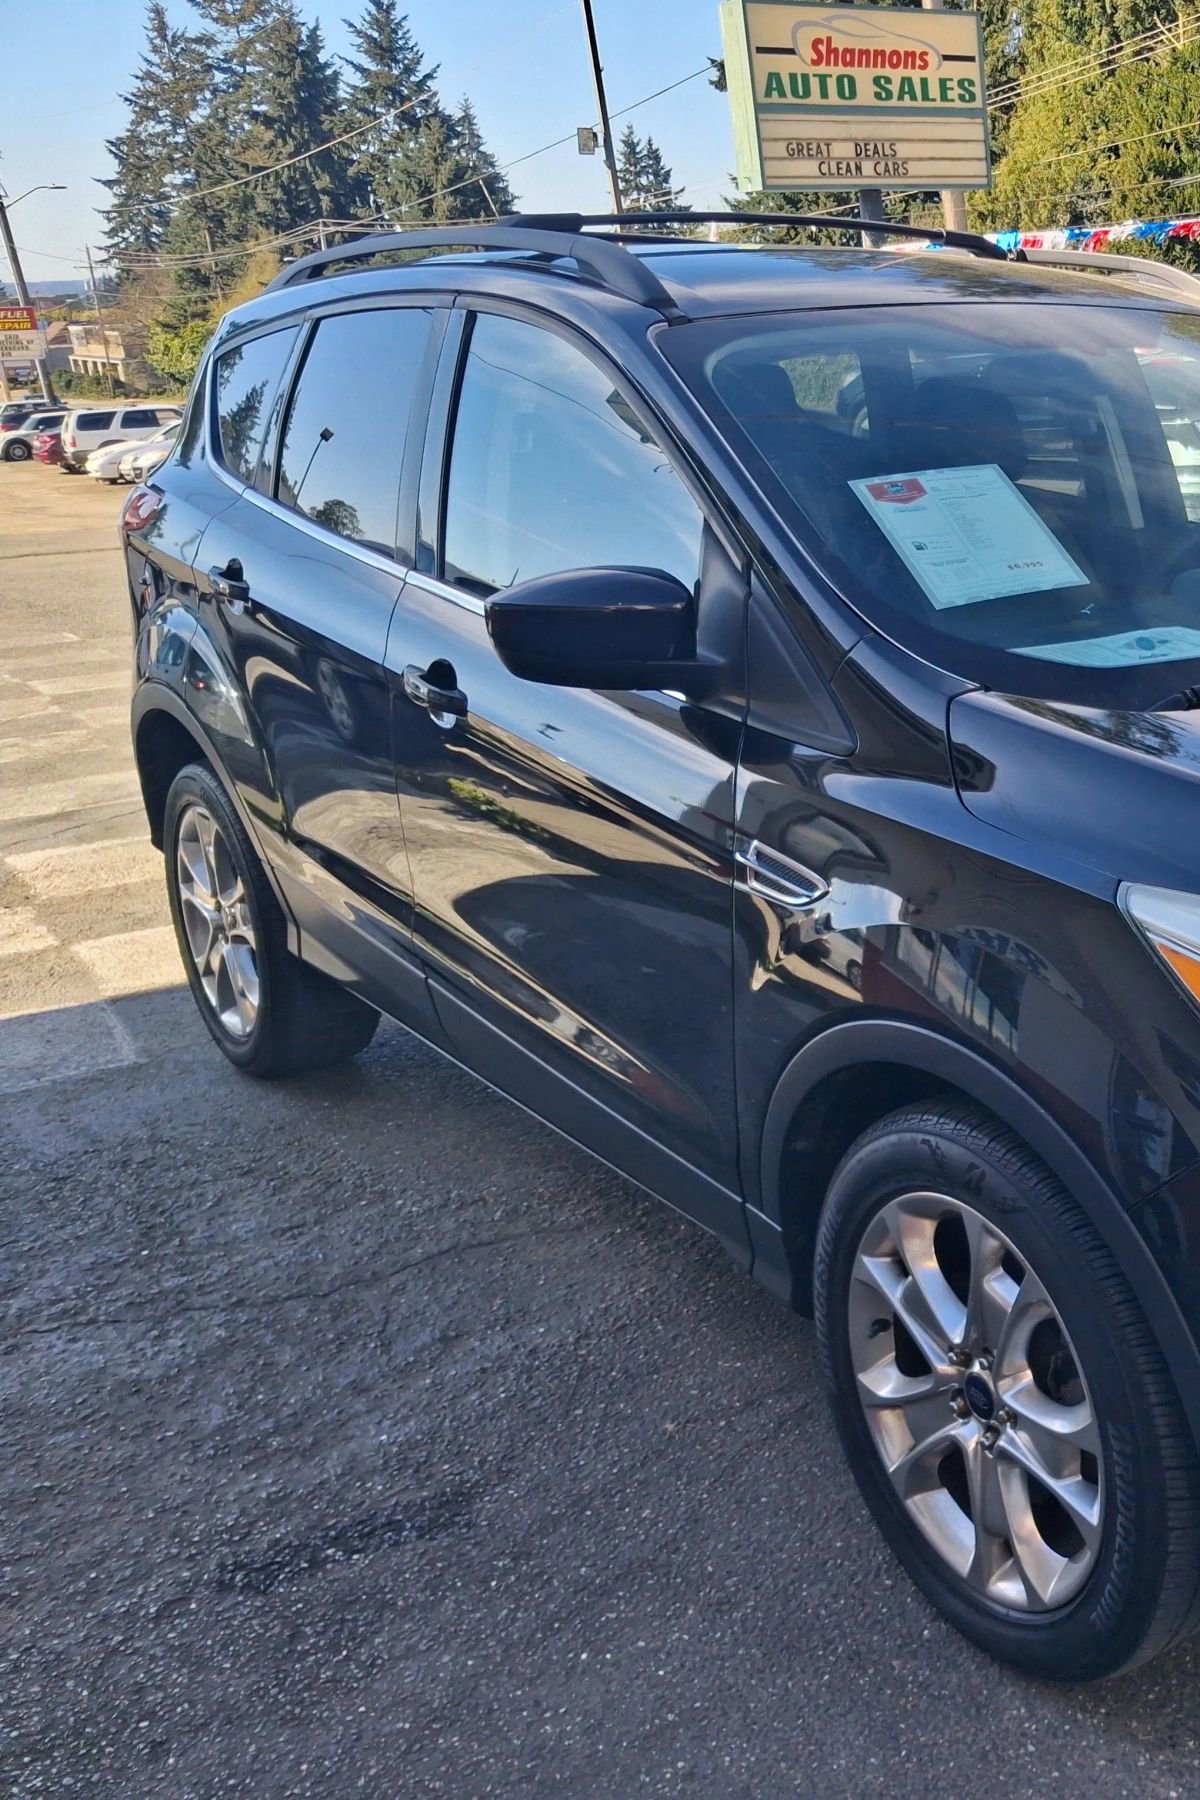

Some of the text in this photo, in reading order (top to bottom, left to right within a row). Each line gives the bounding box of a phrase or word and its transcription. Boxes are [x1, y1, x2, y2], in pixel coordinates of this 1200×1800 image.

[810, 36, 929, 71] Shannons
[764, 72, 977, 103] AUTO SALES
[786, 142, 897, 158] GREAT DEALS
[818, 161, 909, 176] CLEAN CARS
[0, 310, 30, 319] FUEL
[0, 322, 32, 330] EPAIR
